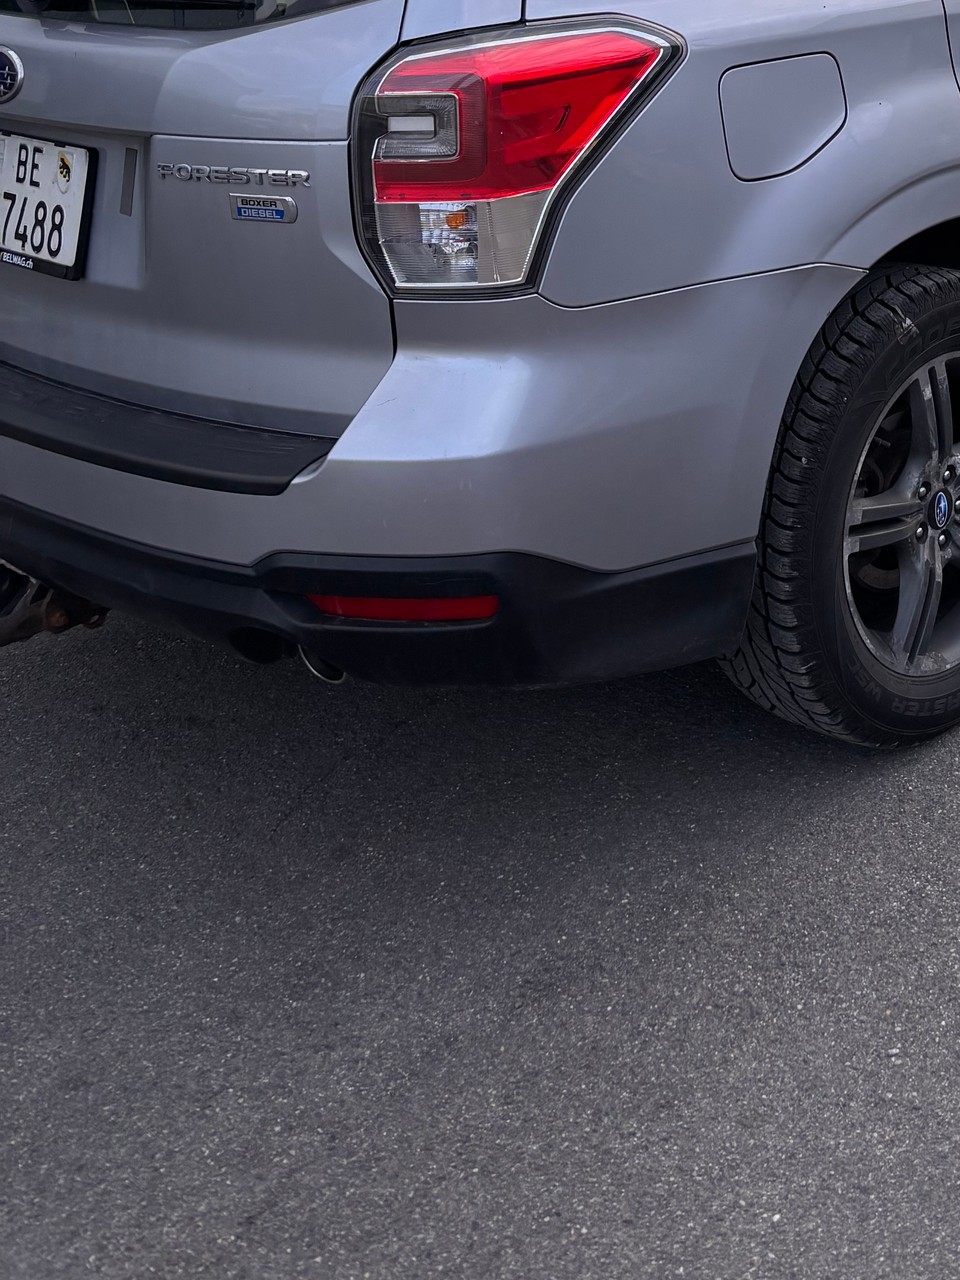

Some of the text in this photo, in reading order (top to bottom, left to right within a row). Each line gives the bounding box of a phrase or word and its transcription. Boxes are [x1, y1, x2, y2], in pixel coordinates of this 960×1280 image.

[16, 144, 44, 188] BE
[157, 163, 312, 187] FORESTER
[240, 198, 278, 209] BOXER
[241, 209, 281, 219] DIESEL
[3, 192, 65, 258] 7488
